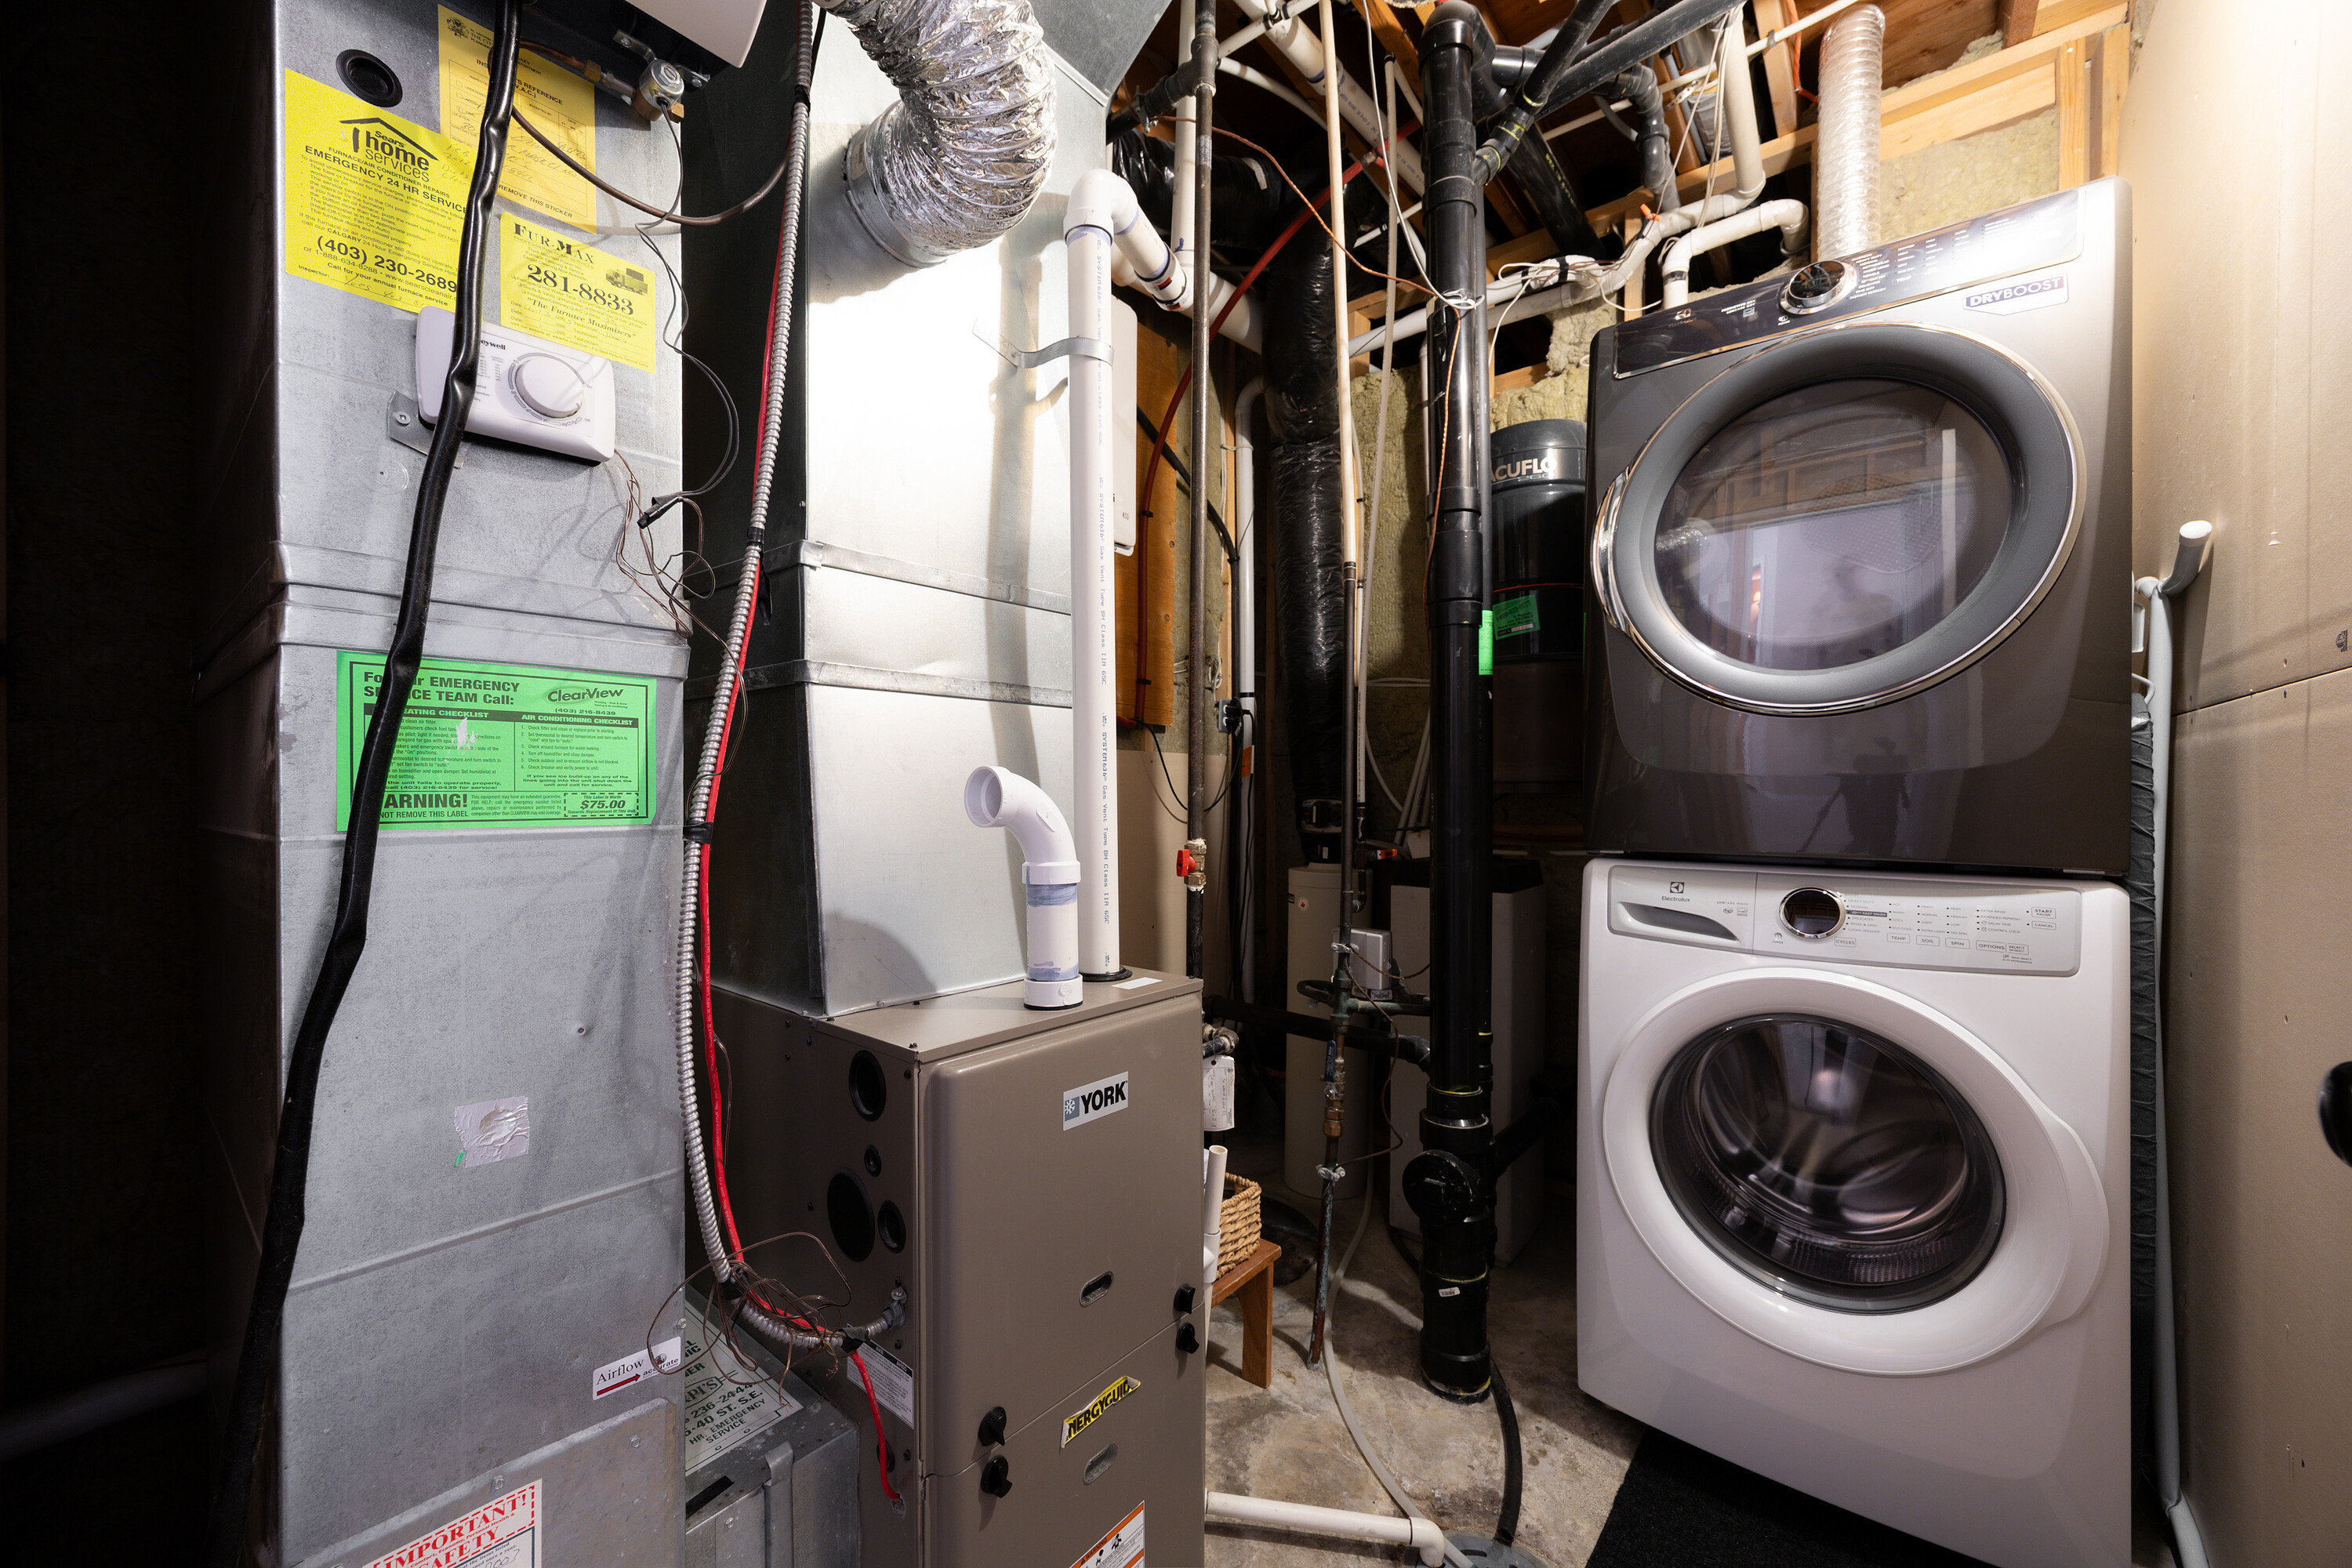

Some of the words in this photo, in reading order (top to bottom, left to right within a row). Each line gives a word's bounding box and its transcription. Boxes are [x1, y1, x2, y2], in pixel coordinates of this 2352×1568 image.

[524, 82, 562, 105] REFERENCE
[365, 129, 430, 172] home
[374, 129, 405, 147] Sears
[305, 144, 383, 181] EMERGENCY
[387, 176, 399, 187] 24
[403, 183, 419, 195] HR
[328, 147, 375, 169] FURNACE/AIR
[376, 165, 421, 187] CONDITIONER
[423, 183, 450, 198] REPAIRS
[365, 147, 430, 183] services
[498, 183, 527, 200] REMOVE
[529, 196, 543, 206] THIS
[545, 202, 572, 218] STICKER
[327, 227, 361, 242] CALGARY
[315, 249, 377, 274] 1-888-634-8288
[317, 234, 367, 265] (403)
[373, 254, 457, 293] 230-2689
[327, 261, 341, 270] Call
[355, 271, 371, 281] your
[368, 275, 396, 289] annual
[397, 285, 423, 298] furnace
[424, 295, 448, 306] service
[527, 262, 633, 317] 281-8833
[1970, 278, 2060, 307] DRYBOOST
[551, 305, 585, 322] Furnace
[364, 671, 383, 683] Fo
[430, 676, 519, 692] EMERGENCY
[436, 690, 477, 702] TEAM
[482, 693, 514, 705] Call:
[547, 688, 624, 703] ClearView
[403, 707, 435, 716] EATING
[438, 710, 488, 718] CHECKLIST
[537, 715, 592, 724] CONDITIONING
[383, 793, 467, 808] ARNING!
[580, 800, 625, 809] $75.00
[1080, 1080, 1127, 1114] YORK
[596, 1359, 644, 1385] Airflow
[710, 1399, 766, 1433] EMERGENCY
[706, 1418, 746, 1443] SERVICE
[466, 1526, 490, 1539] Personal
[491, 1515, 510, 1527] Health
